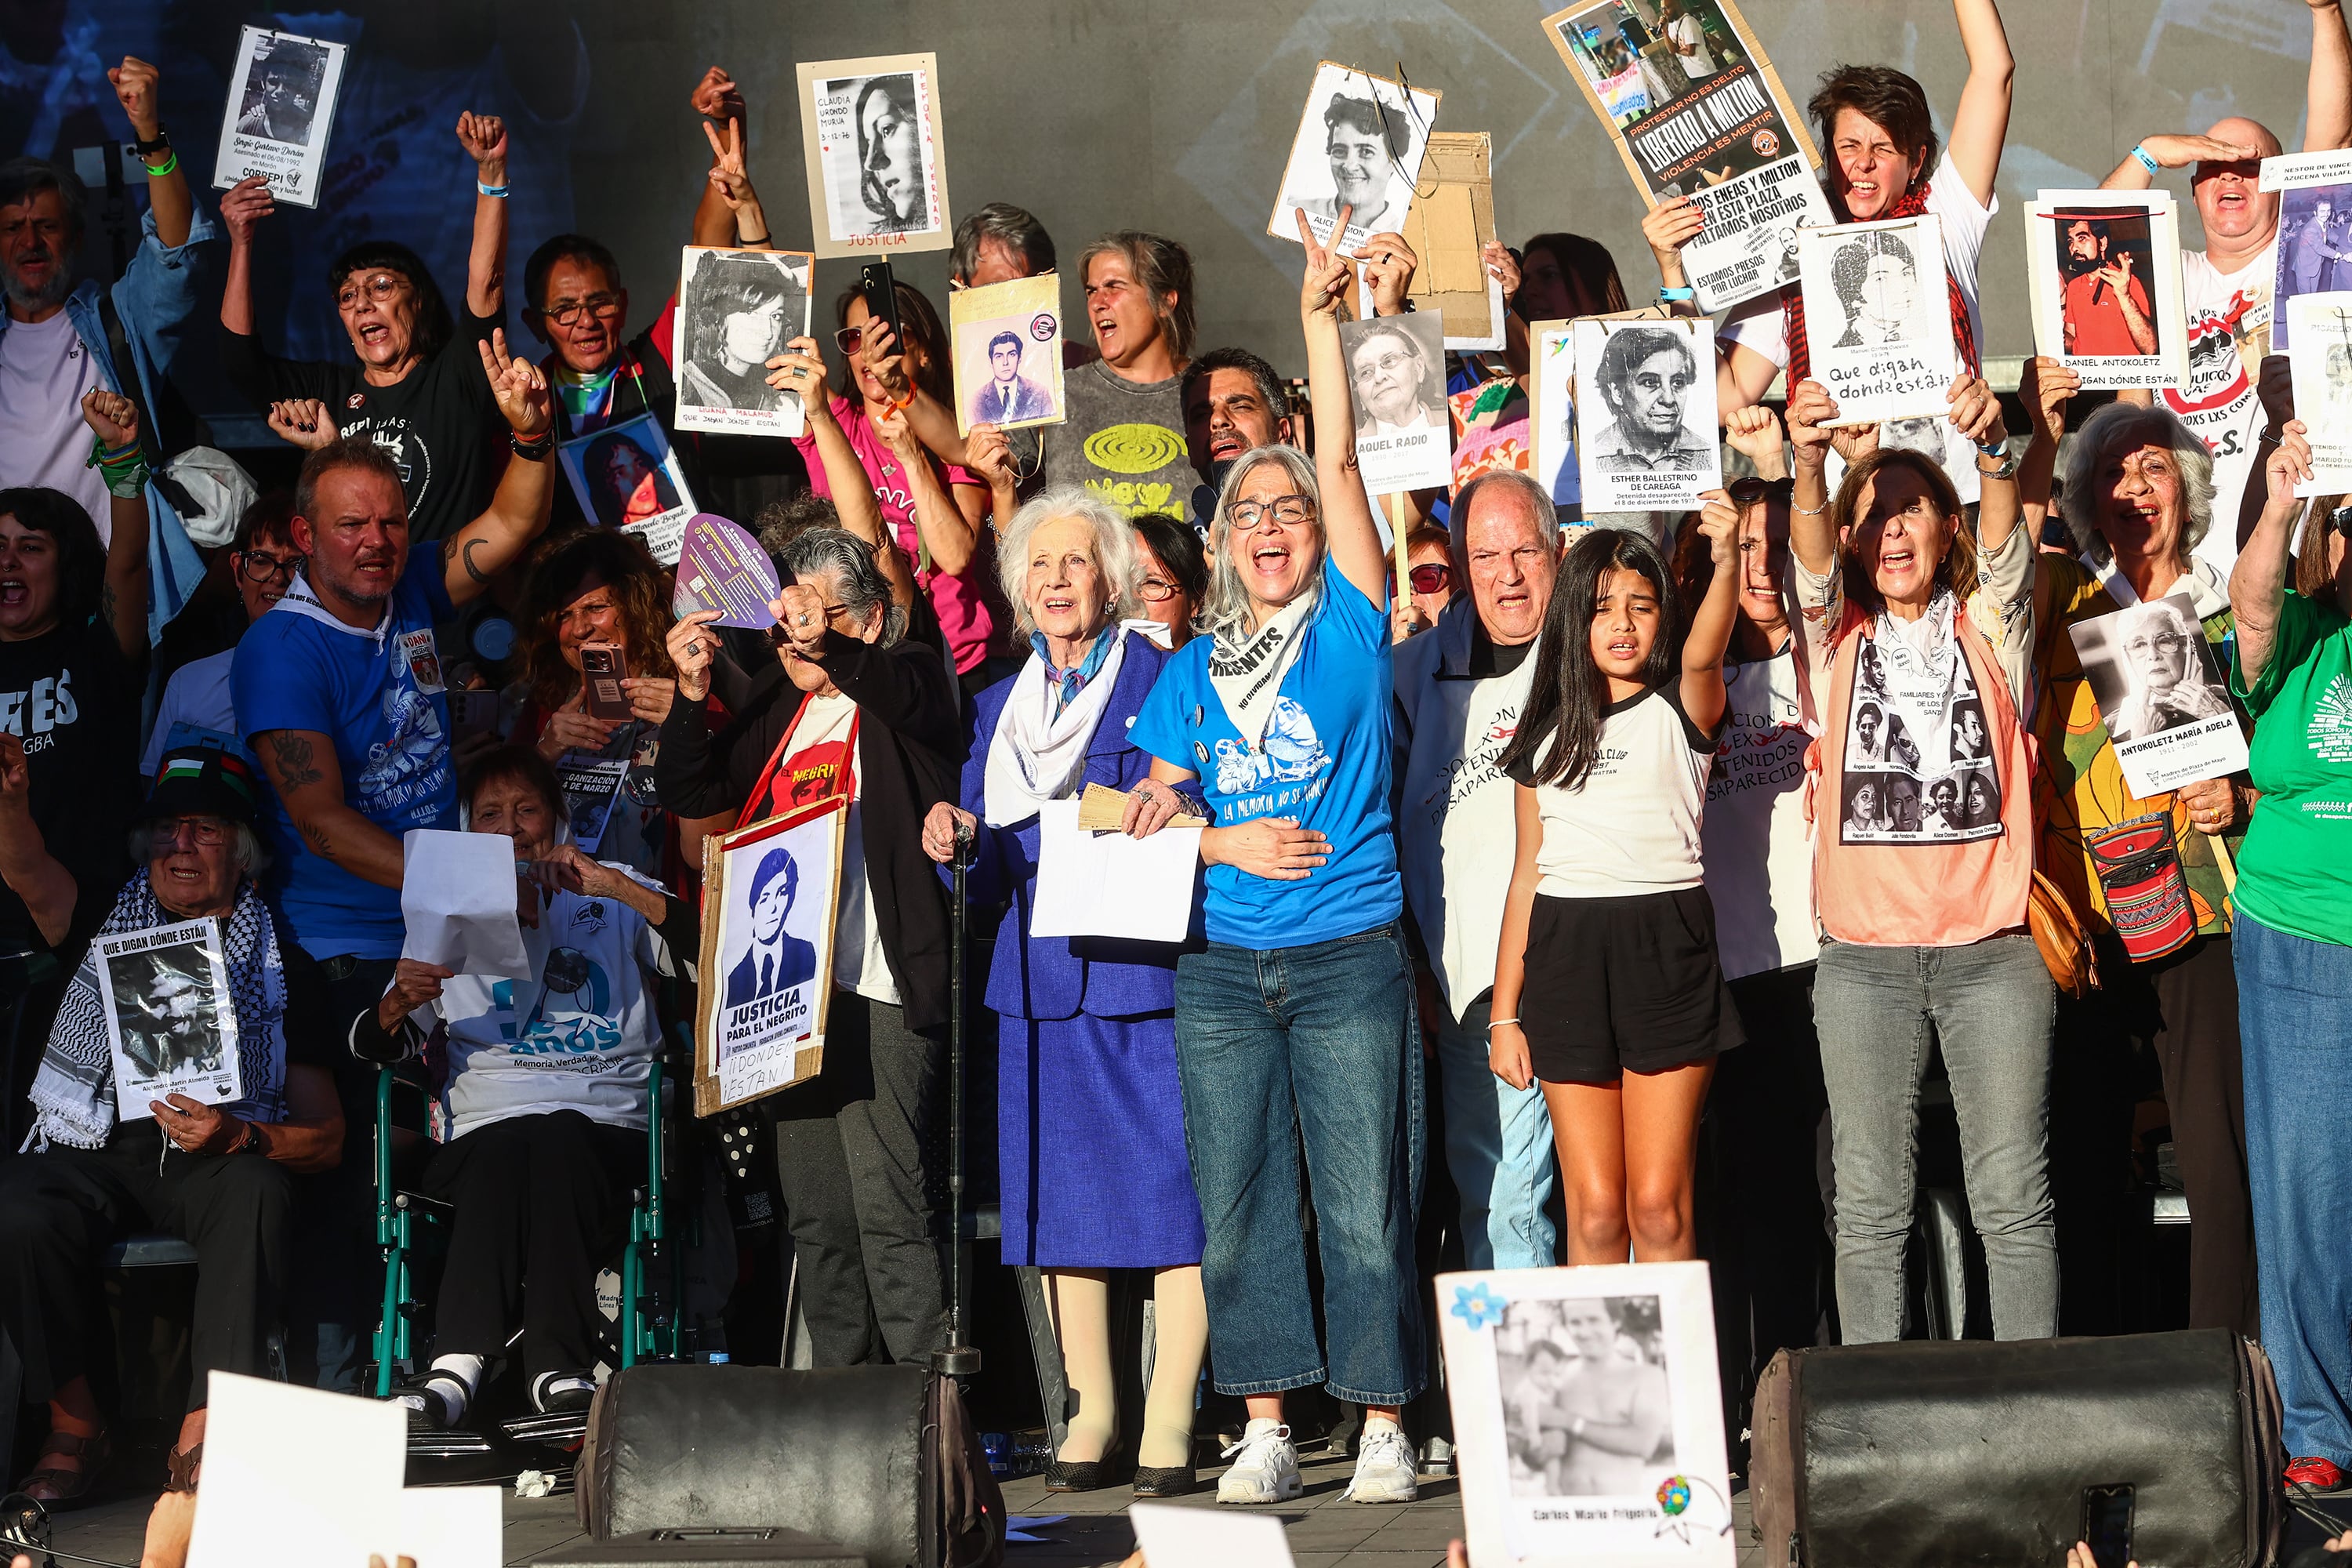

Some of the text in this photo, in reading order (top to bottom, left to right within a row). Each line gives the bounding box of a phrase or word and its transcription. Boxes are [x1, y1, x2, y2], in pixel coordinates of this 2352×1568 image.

[1630, 101, 1684, 137] PROTESTAR
[1684, 93, 1699, 105] NO
[1698, 84, 1713, 95] ES
[1712, 65, 1746, 88] DELITO
[1705, 74, 1768, 132] MILTON
[820, 107, 848, 117] URONDO
[1696, 103, 1720, 139] A
[234, 137, 305, 158] Sergio Gustavo Durán
[1635, 110, 1708, 173] LIBERTAD
[1659, 147, 1717, 182] VIOLENCIA
[1717, 136, 1732, 150] ES
[1731, 111, 1774, 140] MENTIR
[234, 148, 260, 158] Asesinado
[267, 154, 301, 167] 06/08/1992
[259, 161, 277, 169] Morón
[285, 187, 303, 196] lucha!
[1713, 159, 1802, 208] ENEAS Y MILTON
[929, 163, 940, 225] VERDAD
[1704, 185, 1782, 227] EN ESTA PLAZA
[1314, 216, 1334, 227] ALICE
[1693, 193, 1807, 249] FALTAMOS NOSOTROS
[848, 231, 906, 246] JUSTICIA
[1697, 254, 1766, 289] ESTAMOS PRESOS
[1711, 281, 1728, 295] POR
[1727, 269, 1759, 289] LUCHAR
[2242, 304, 2267, 320] SUSANA
[1830, 358, 1924, 382] Que digan
[2110, 375, 2142, 384] DÓNDE
[2146, 374, 2178, 384] ESTÁN!
[683, 414, 698, 423] QUE
[736, 410, 773, 419] MALAMUD
[2209, 410, 2227, 423] LXS
[1359, 434, 1428, 453] AQUEL RADIO
[1642, 474, 1697, 482] BALLESTRINO
[630, 508, 688, 532] Marcelo Bogado
[296, 594, 306, 603] NOS
[408, 633, 427, 647] DANI
[1238, 697, 1249, 710] NO
[23, 733, 55, 754] GBA
[1733, 733, 1754, 750] EX
[2121, 719, 2233, 757] ANTOKOLETZ MARÍA ADELA
[1606, 749, 1628, 760] CLUB
[1719, 740, 1798, 772] TENIDOS
[2159, 740, 2198, 756] 1911 2002
[781, 768, 791, 777] EL
[2161, 770, 2181, 779] Madres
[2189, 763, 2204, 771] Plaza
[2176, 768, 2205, 779] Fundadora
[569, 781, 611, 793] DE MARZO
[1707, 762, 1800, 801] SAPARECID
[358, 775, 437, 814] LA NO SE
[1224, 803, 1234, 821] LA
[1237, 794, 1274, 818] MEMORIA
[1277, 789, 1290, 808] NO
[103, 924, 207, 956] QUE DIGAN DÓNDE ESTÁN
[730, 988, 800, 1028] JUSTICIA
[727, 1004, 807, 1042] PARA EL NEGRITO
[514, 1055, 588, 1069] Memoria, Verdad
[188, 1075, 209, 1084] Almeida
